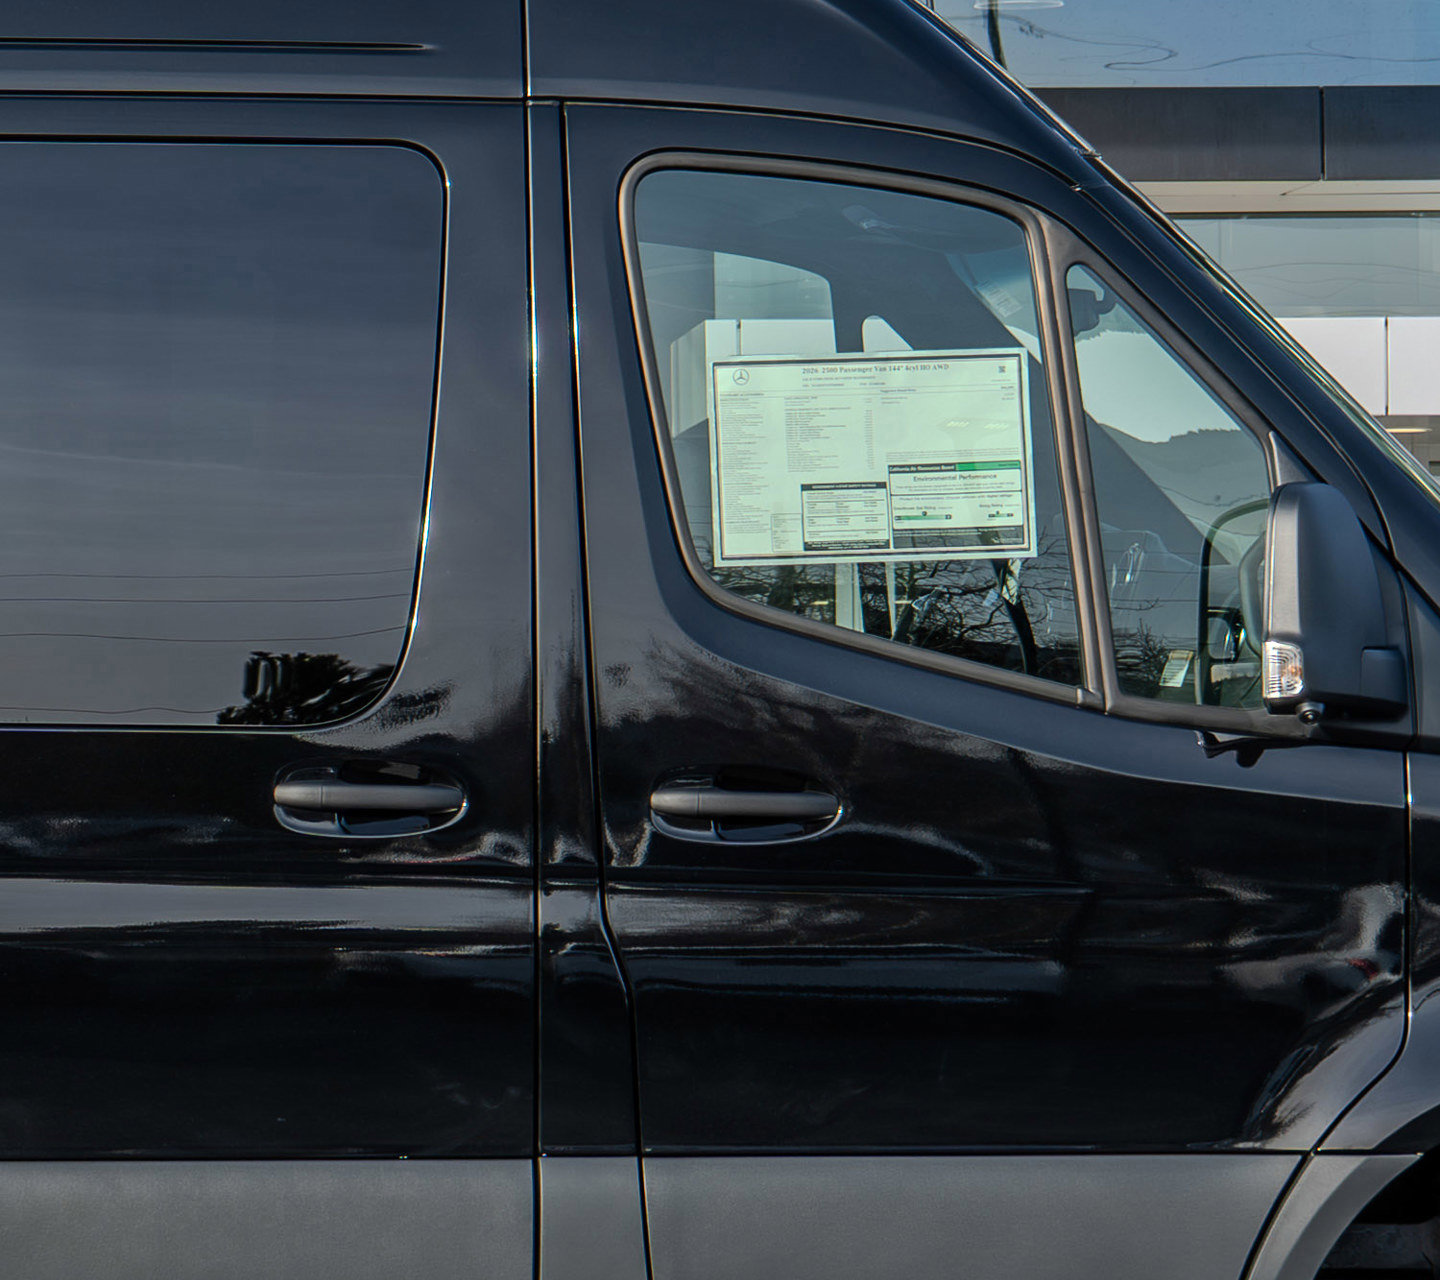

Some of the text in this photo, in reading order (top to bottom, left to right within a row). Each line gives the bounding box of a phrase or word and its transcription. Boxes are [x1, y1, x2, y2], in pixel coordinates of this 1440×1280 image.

[822, 366, 838, 374] 2500
[839, 366, 873, 375] Passenger
[913, 472, 997, 482] Environmental Performance
